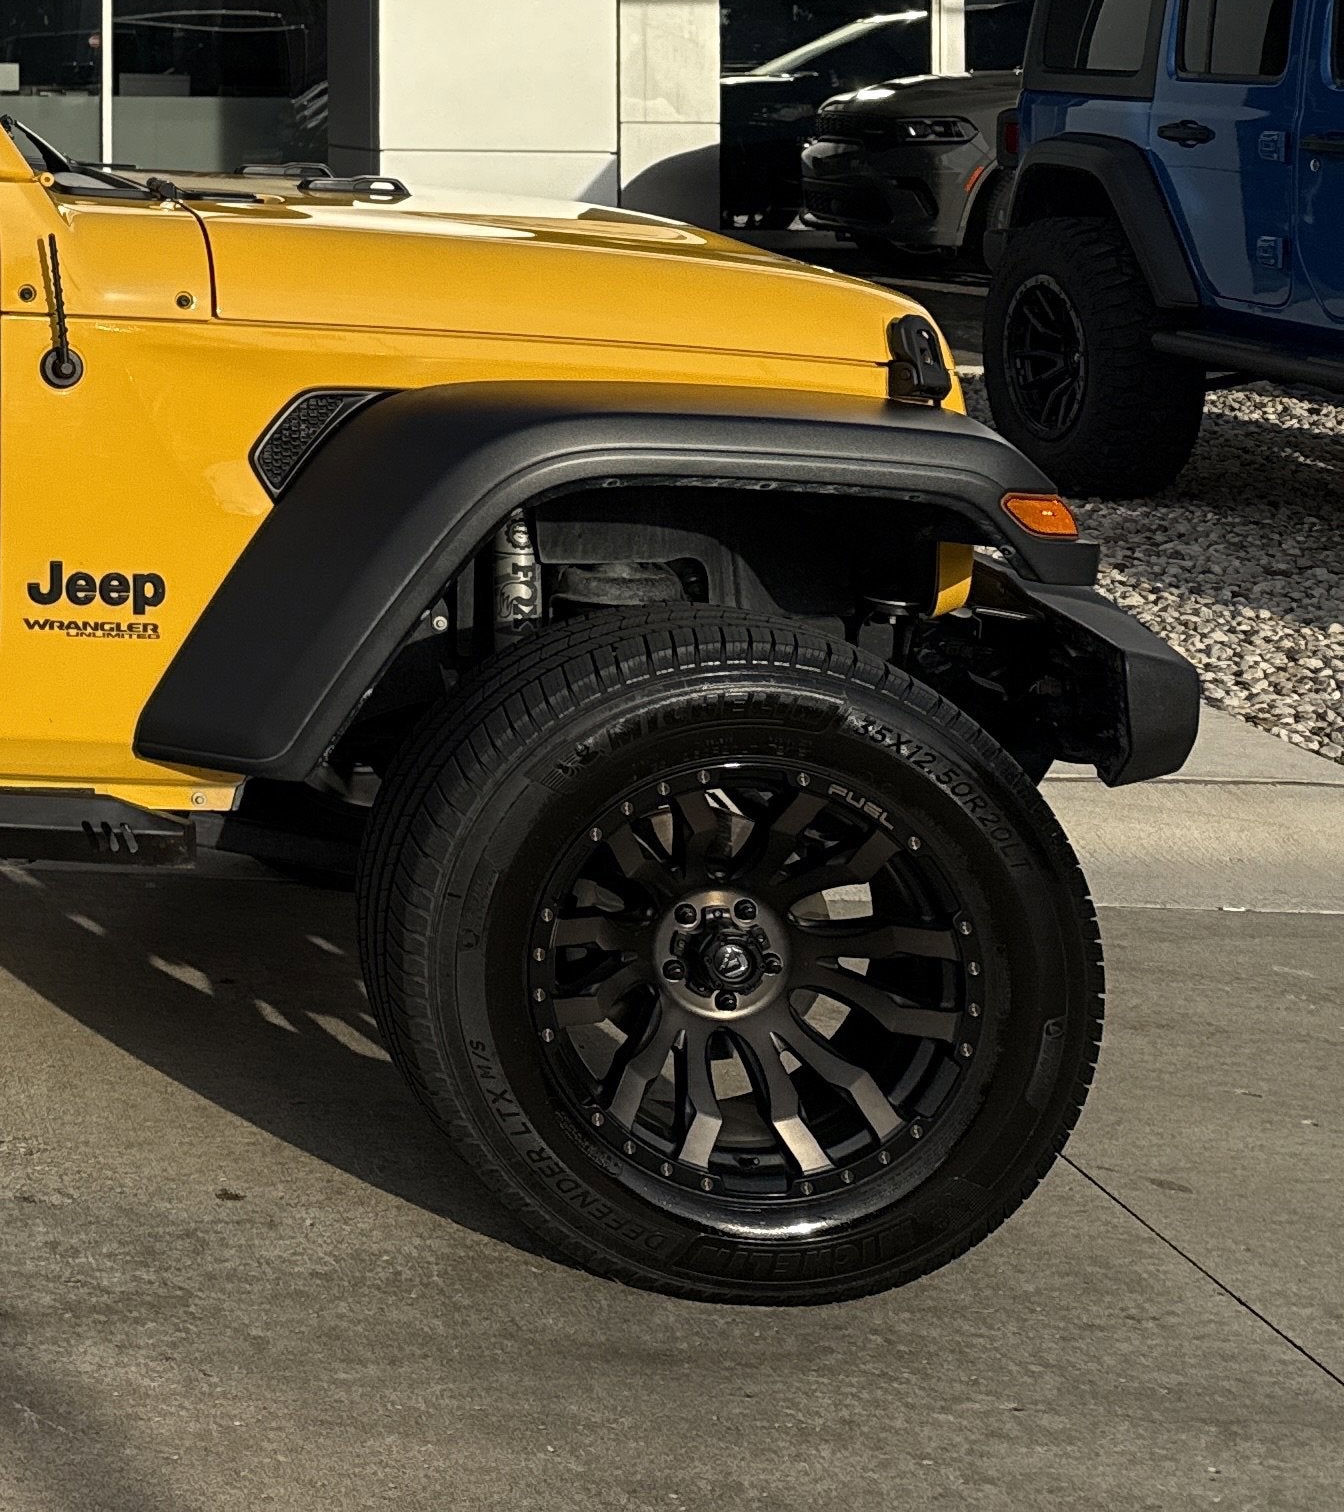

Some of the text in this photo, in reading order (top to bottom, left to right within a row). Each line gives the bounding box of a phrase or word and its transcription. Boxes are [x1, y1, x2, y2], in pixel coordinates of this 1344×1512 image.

[26, 560, 166, 616] Jeep
[22, 617, 160, 634] WRANGLER
[65, 631, 161, 640] UNLIMITED
[828, 783, 894, 830] FUEL
[469, 1039, 496, 1080] M/S
[486, 1087, 533, 1137] LTX
[525, 1146, 670, 1251] DEFENDER
